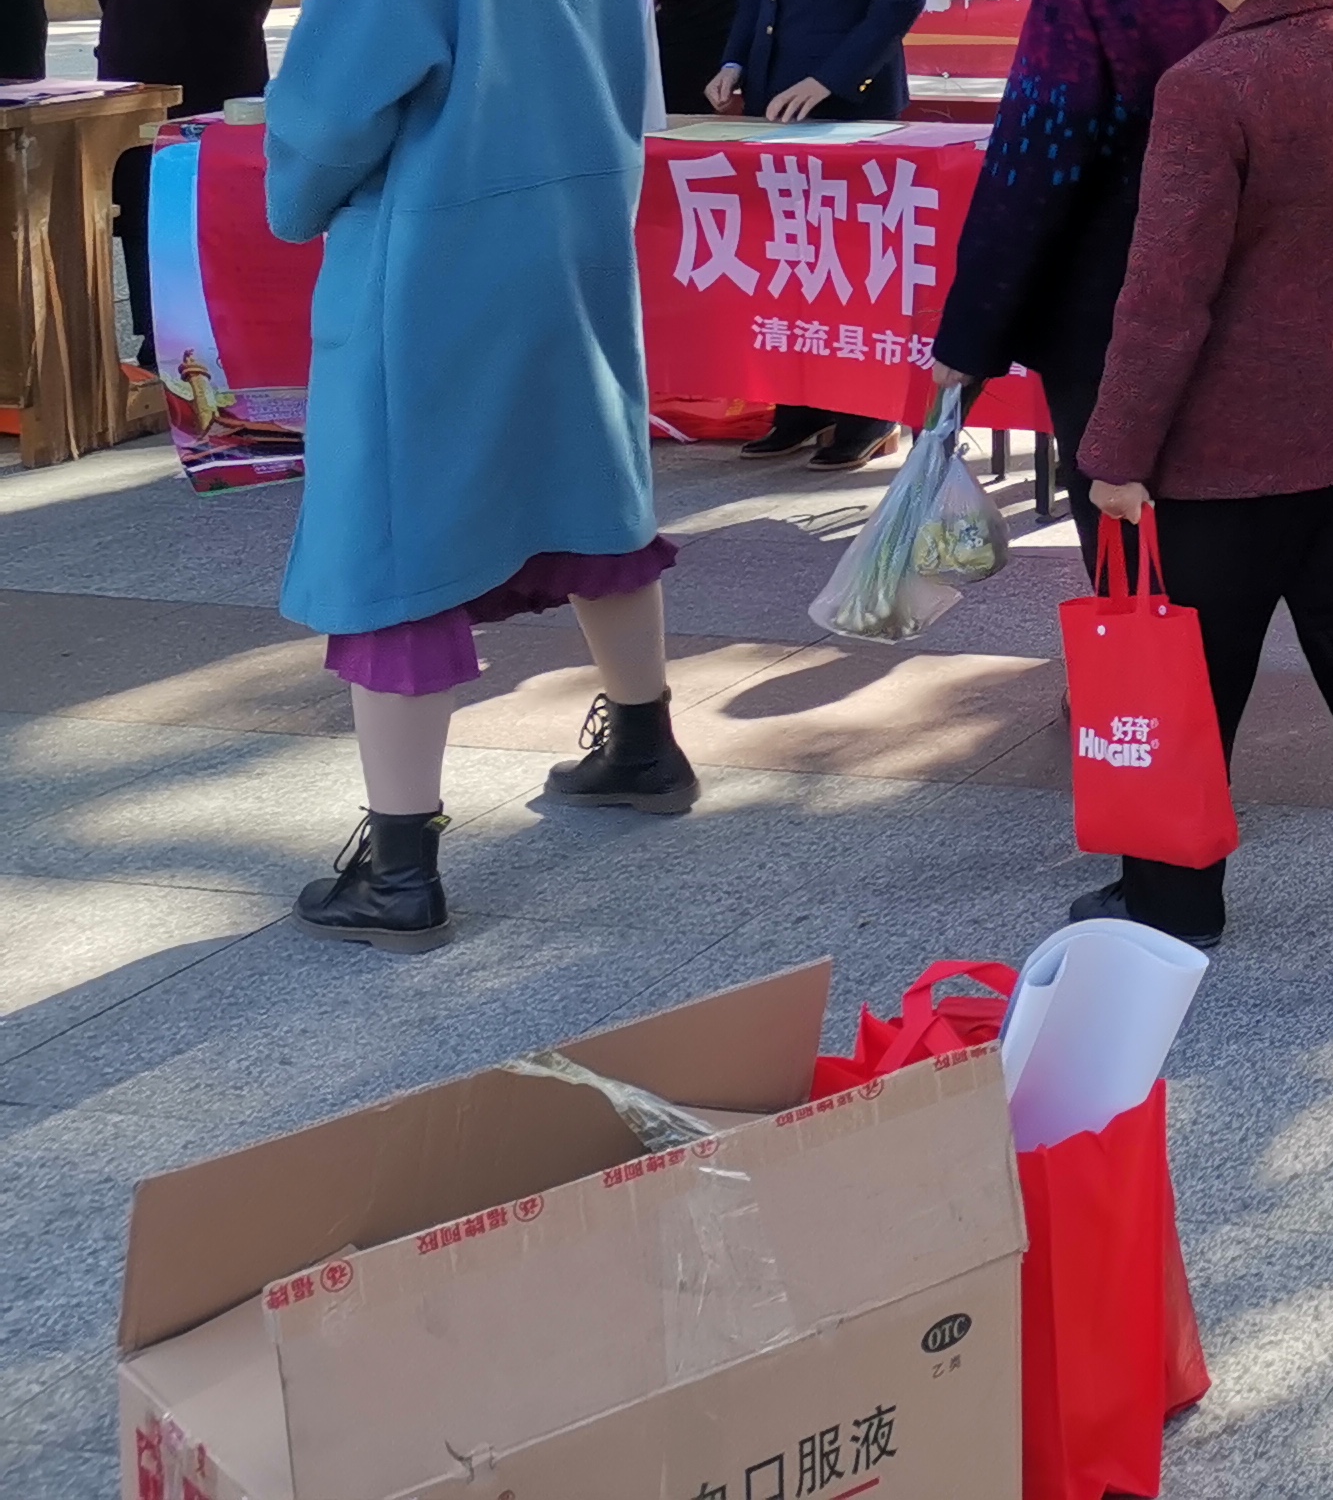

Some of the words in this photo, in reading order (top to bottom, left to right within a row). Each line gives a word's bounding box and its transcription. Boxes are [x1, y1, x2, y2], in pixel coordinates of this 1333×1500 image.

[667, 152, 939, 316] 反欺诈
[926, 1320, 968, 1350] OTC
